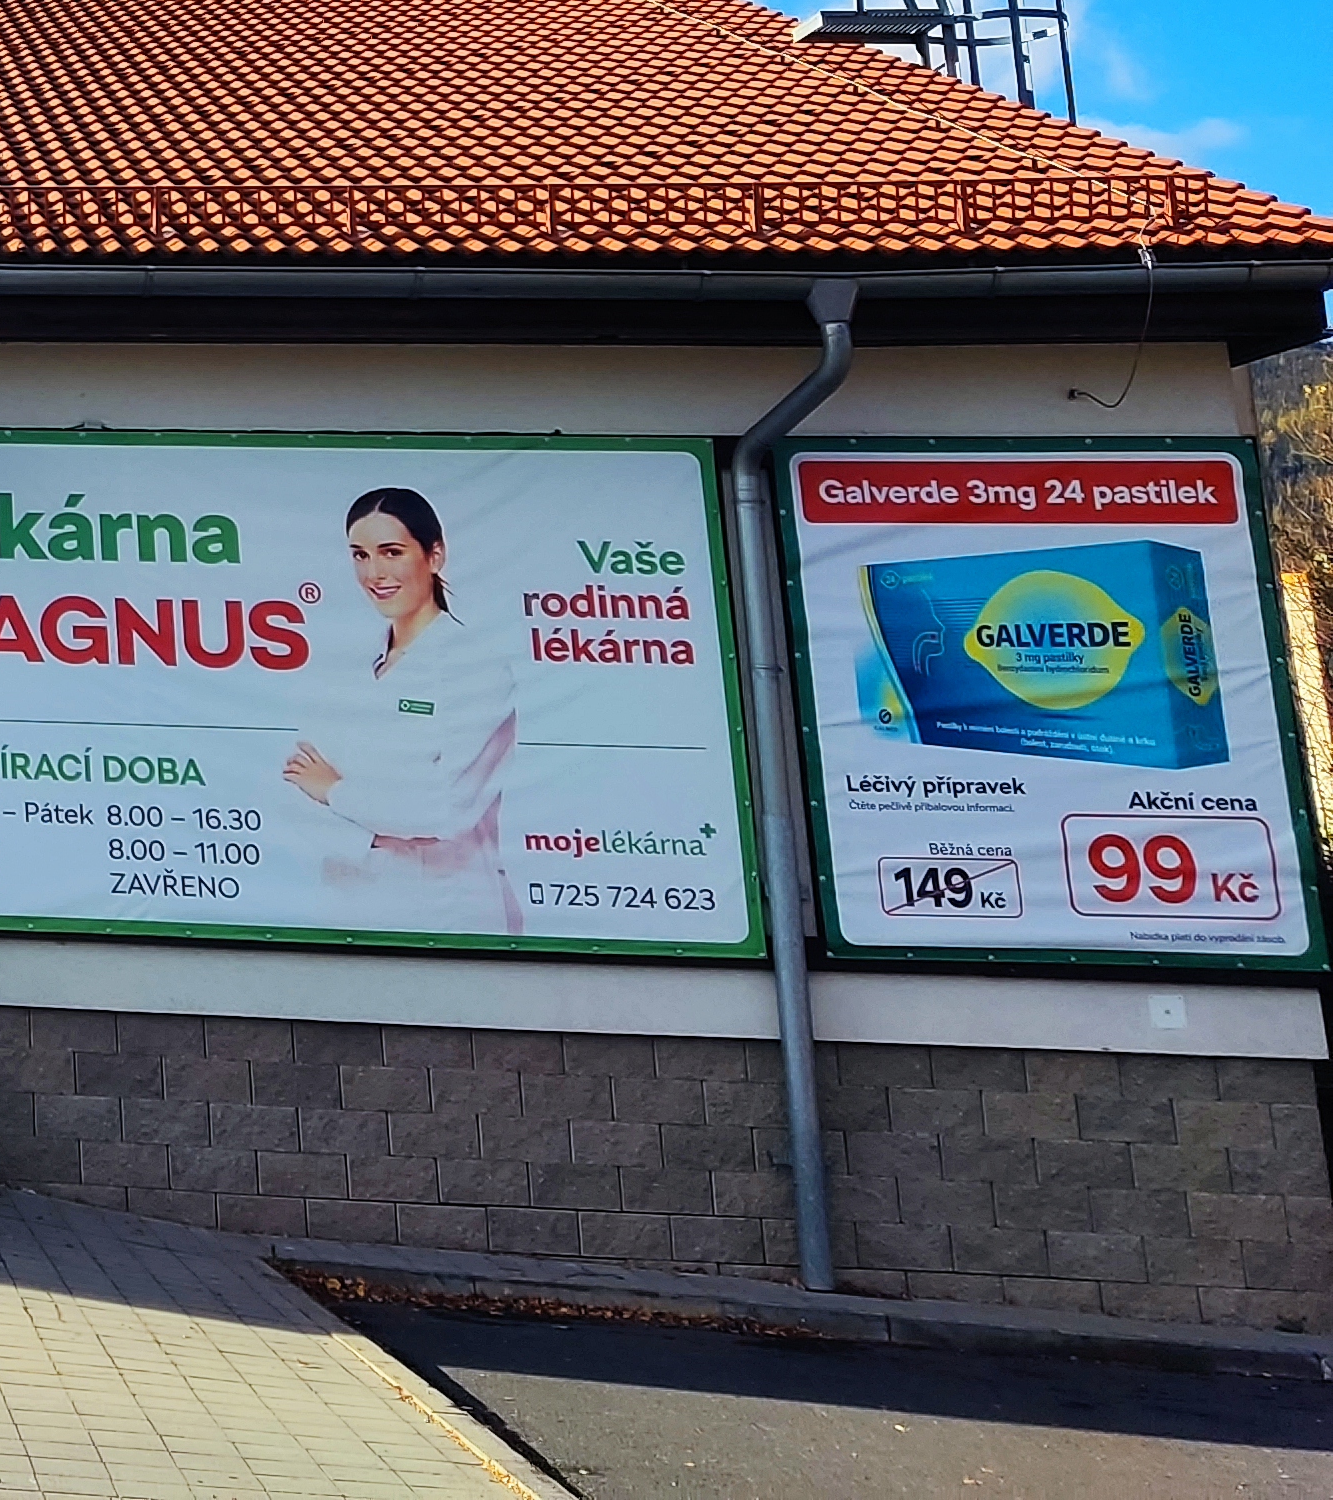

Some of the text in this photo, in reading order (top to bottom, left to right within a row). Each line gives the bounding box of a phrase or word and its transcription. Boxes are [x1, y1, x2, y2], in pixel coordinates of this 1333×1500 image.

[818, 479, 1218, 511] Galverde 3mg 24 pastilek
[576, 539, 686, 576] Vaše
[522, 583, 691, 621] rodinná
[531, 627, 695, 665] lékárna
[976, 621, 1132, 648] GALVERDE
[1015, 652, 1022, 662] 3
[1024, 653, 1041, 664] mg
[1178, 613, 1202, 697] GALVERDE
[101, 754, 206, 787] DOBA
[846, 774, 1027, 799] Léčivý přípravek
[1128, 790, 1258, 812] Akční cena
[23, 801, 94, 826] Pátek
[106, 804, 163, 828] 8.00
[192, 808, 262, 832] 16.30
[108, 839, 166, 862] 8.00
[194, 842, 261, 866] 11.00
[524, 827, 707, 858] mojelékárna
[928, 842, 1013, 857] Běžná cena
[110, 868, 240, 899] ZAVŘENO
[1087, 833, 1260, 904] 99 Kč
[549, 883, 716, 910] 725 724 623
[893, 866, 1007, 909] 149 Kč
[1194, 933, 1208, 942] do
